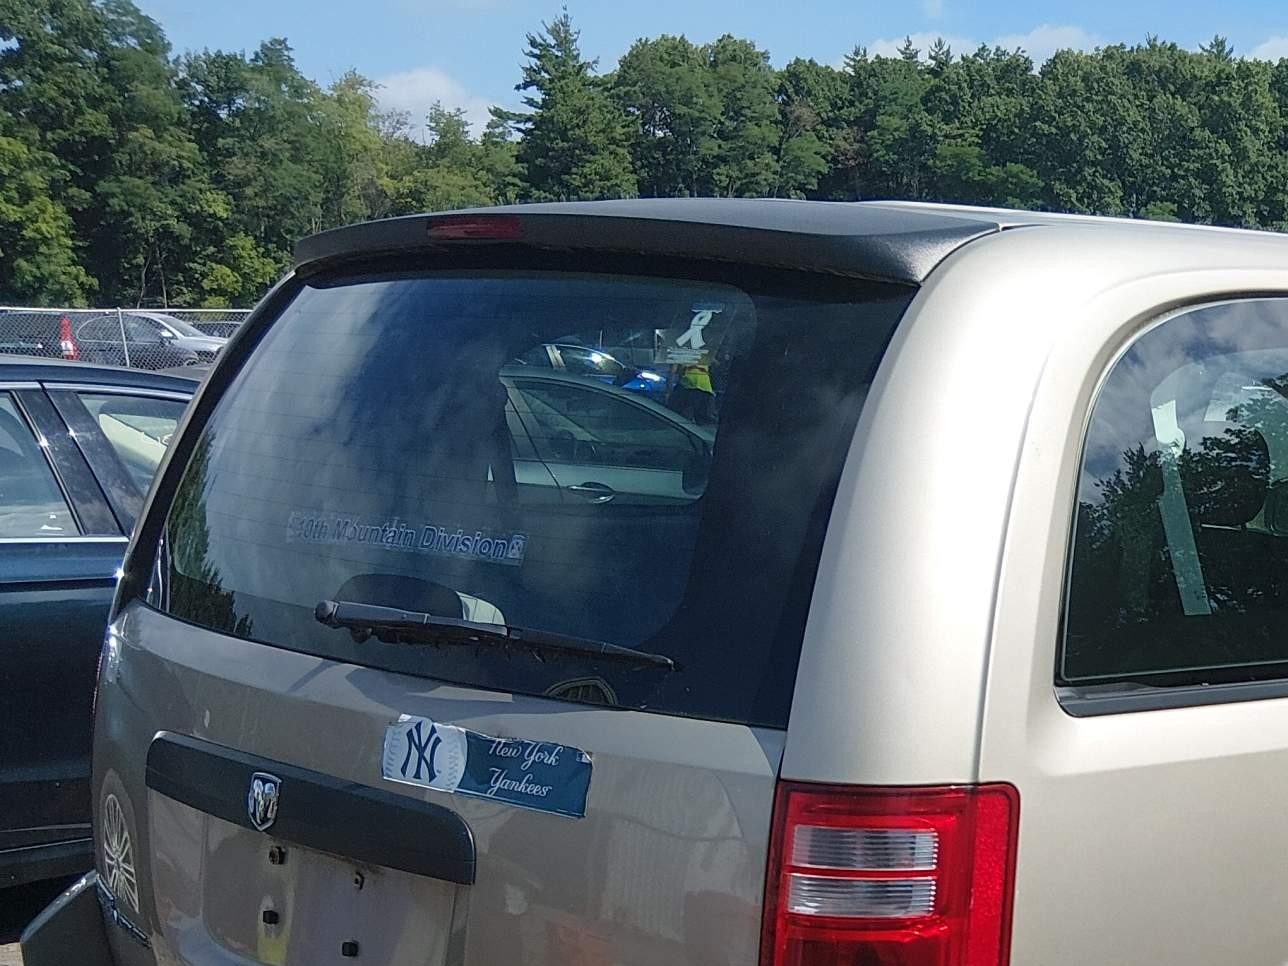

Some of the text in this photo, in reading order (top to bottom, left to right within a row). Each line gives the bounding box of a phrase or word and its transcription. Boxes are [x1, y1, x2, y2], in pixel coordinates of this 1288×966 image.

[333, 518, 417, 548] Mountain
[421, 525, 509, 559] Division
[488, 740, 522, 759] New
[520, 740, 564, 771] York
[488, 767, 552, 797] Yankees
